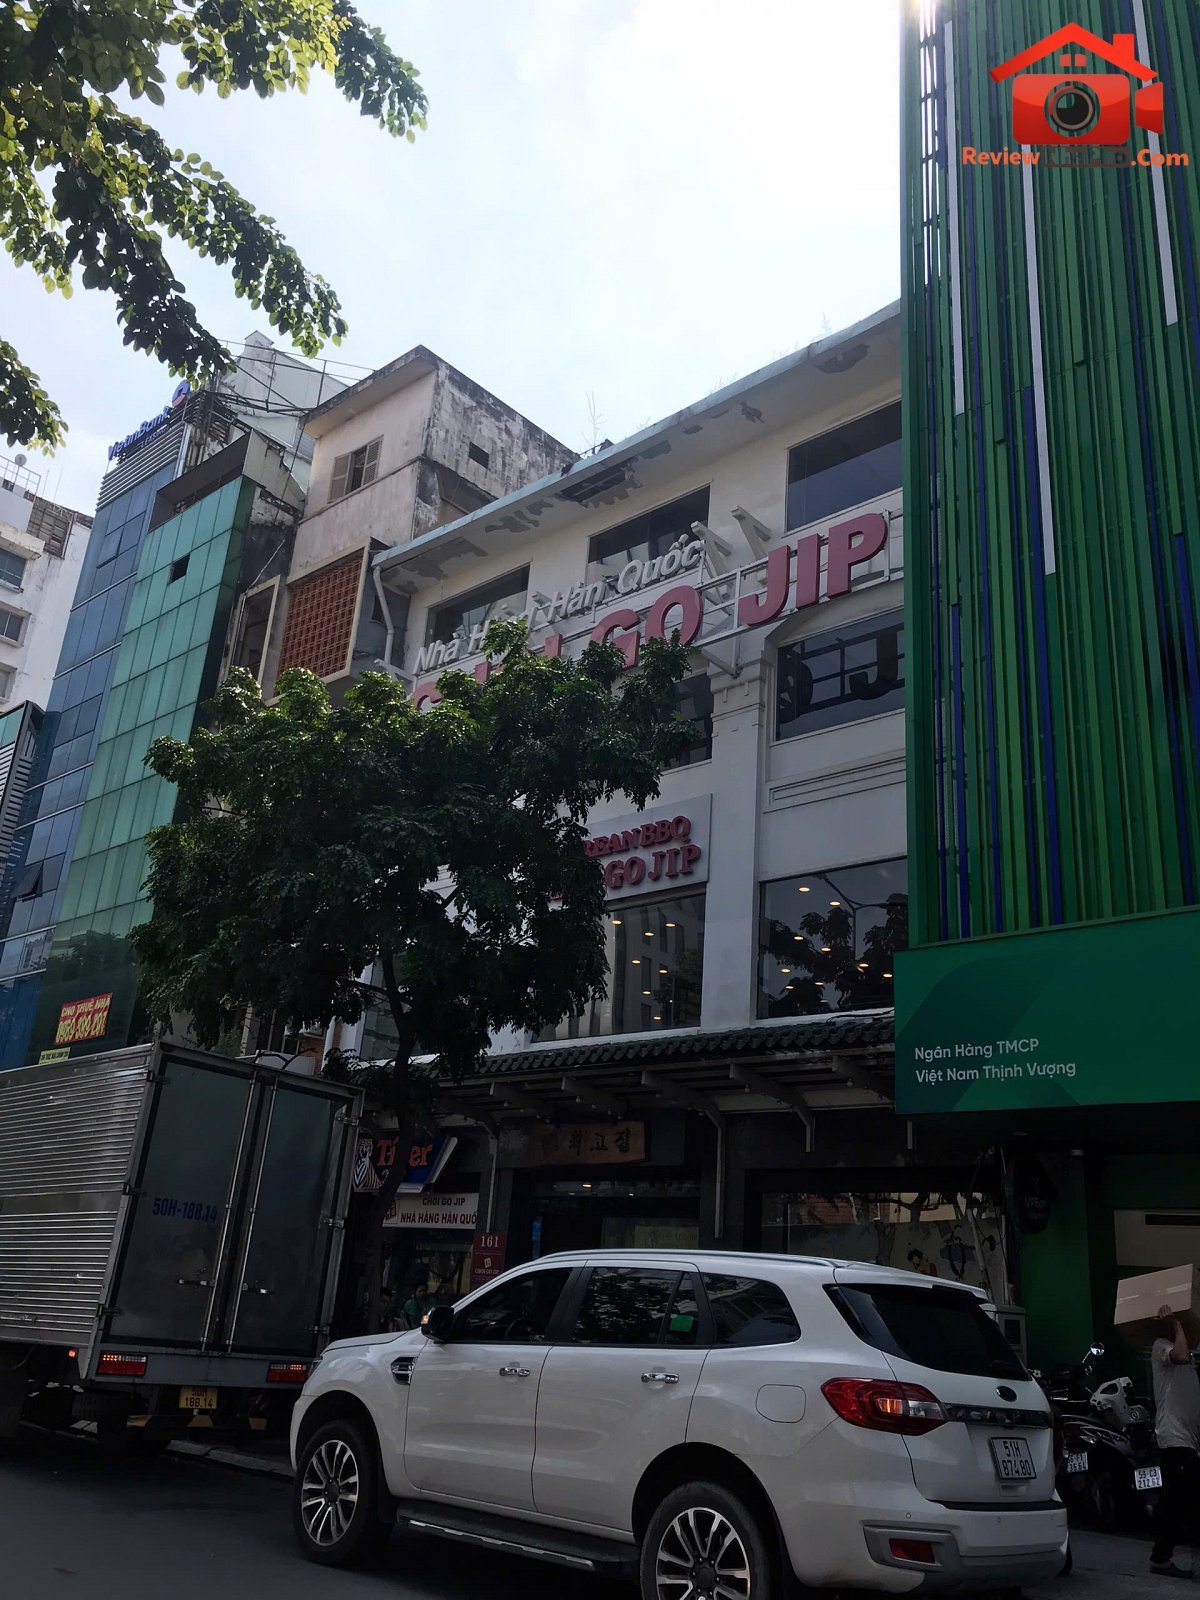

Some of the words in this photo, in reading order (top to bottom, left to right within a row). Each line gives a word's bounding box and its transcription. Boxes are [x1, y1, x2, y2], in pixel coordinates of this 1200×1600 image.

[590, 585, 704, 670] GO
[741, 512, 889, 626] JIP
[412, 632, 460, 676] Nhà
[547, 580, 607, 624] Hàn
[617, 533, 706, 595] Quốc
[604, 856, 647, 889] GO
[648, 844, 702, 881] JIP
[915, 1046, 951, 1063] Ngân
[955, 1043, 993, 1058] Hàng
[997, 1038, 1039, 1055] TMCP
[915, 1069, 943, 1086] Việt
[947, 1067, 979, 1082] Nam
[983, 1064, 1022, 1082] Thịnh
[1026, 1062, 1076, 1079] Vượng
[422, 1197, 440, 1206] CHOI
[441, 1197, 452, 1206] GO
[453, 1197, 466, 1206] JIP
[400, 1210, 416, 1224] NHÀ
[418, 1210, 439, 1224] HÀNG
[441, 1210, 457, 1224] HÀN
[480, 1235, 499, 1248] 161
[1002, 1440, 1022, 1458] 51H
[1002, 1459, 1032, 1477] 874.80
